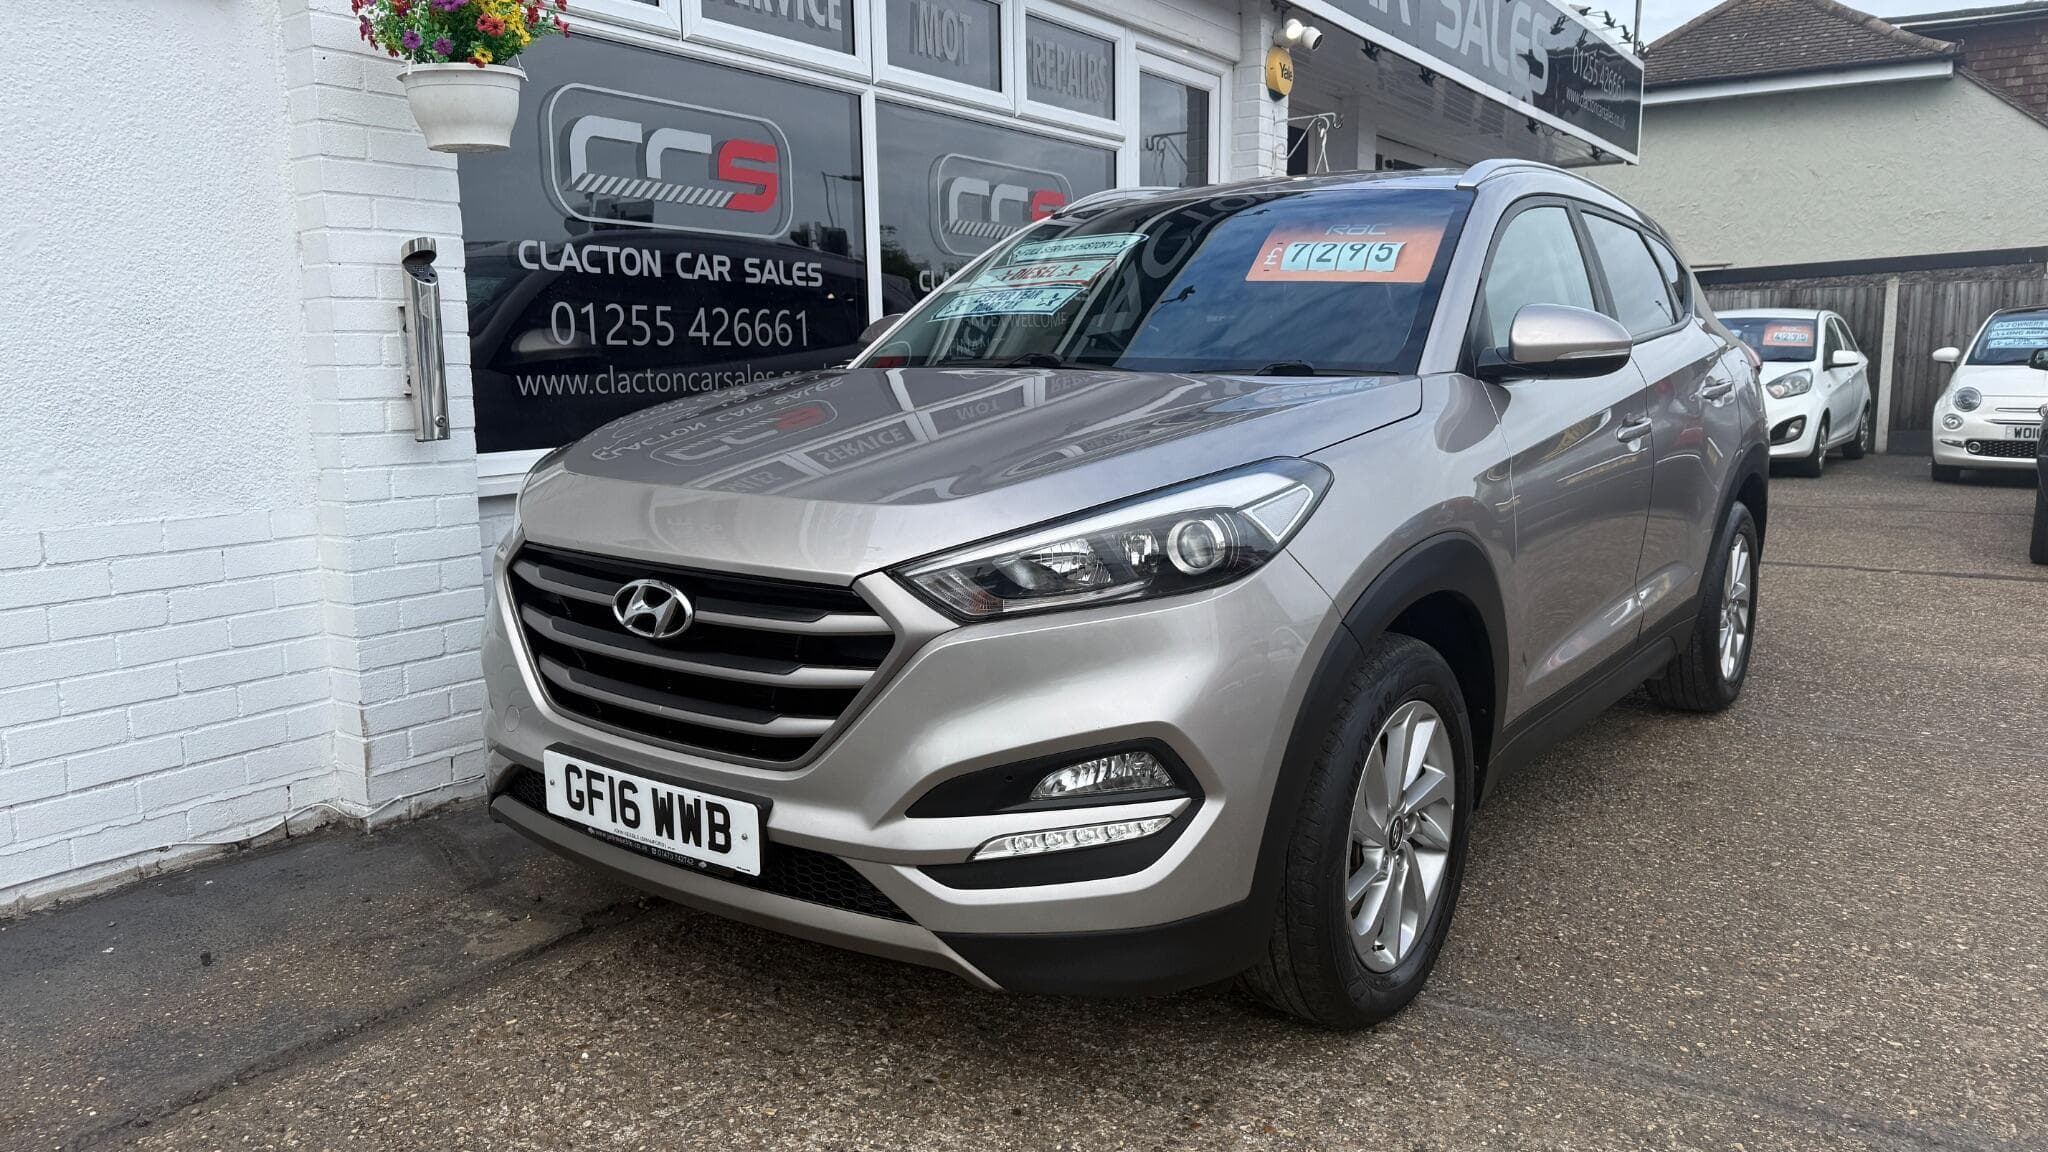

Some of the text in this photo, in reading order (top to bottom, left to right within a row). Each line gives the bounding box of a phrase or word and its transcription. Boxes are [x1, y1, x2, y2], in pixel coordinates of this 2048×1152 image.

[917, 0, 972, 65] MOT
[1032, 37, 1107, 100] REPAIRS
[1279, 62, 1293, 82] Yale
[1572, 46, 1626, 99] 01255 426661
[518, 240, 823, 287] CLACTON CAR SALES
[1009, 264, 1062, 280] DIESEL
[550, 301, 808, 347] 01255 426661
[564, 763, 732, 854] GF16 WWB
